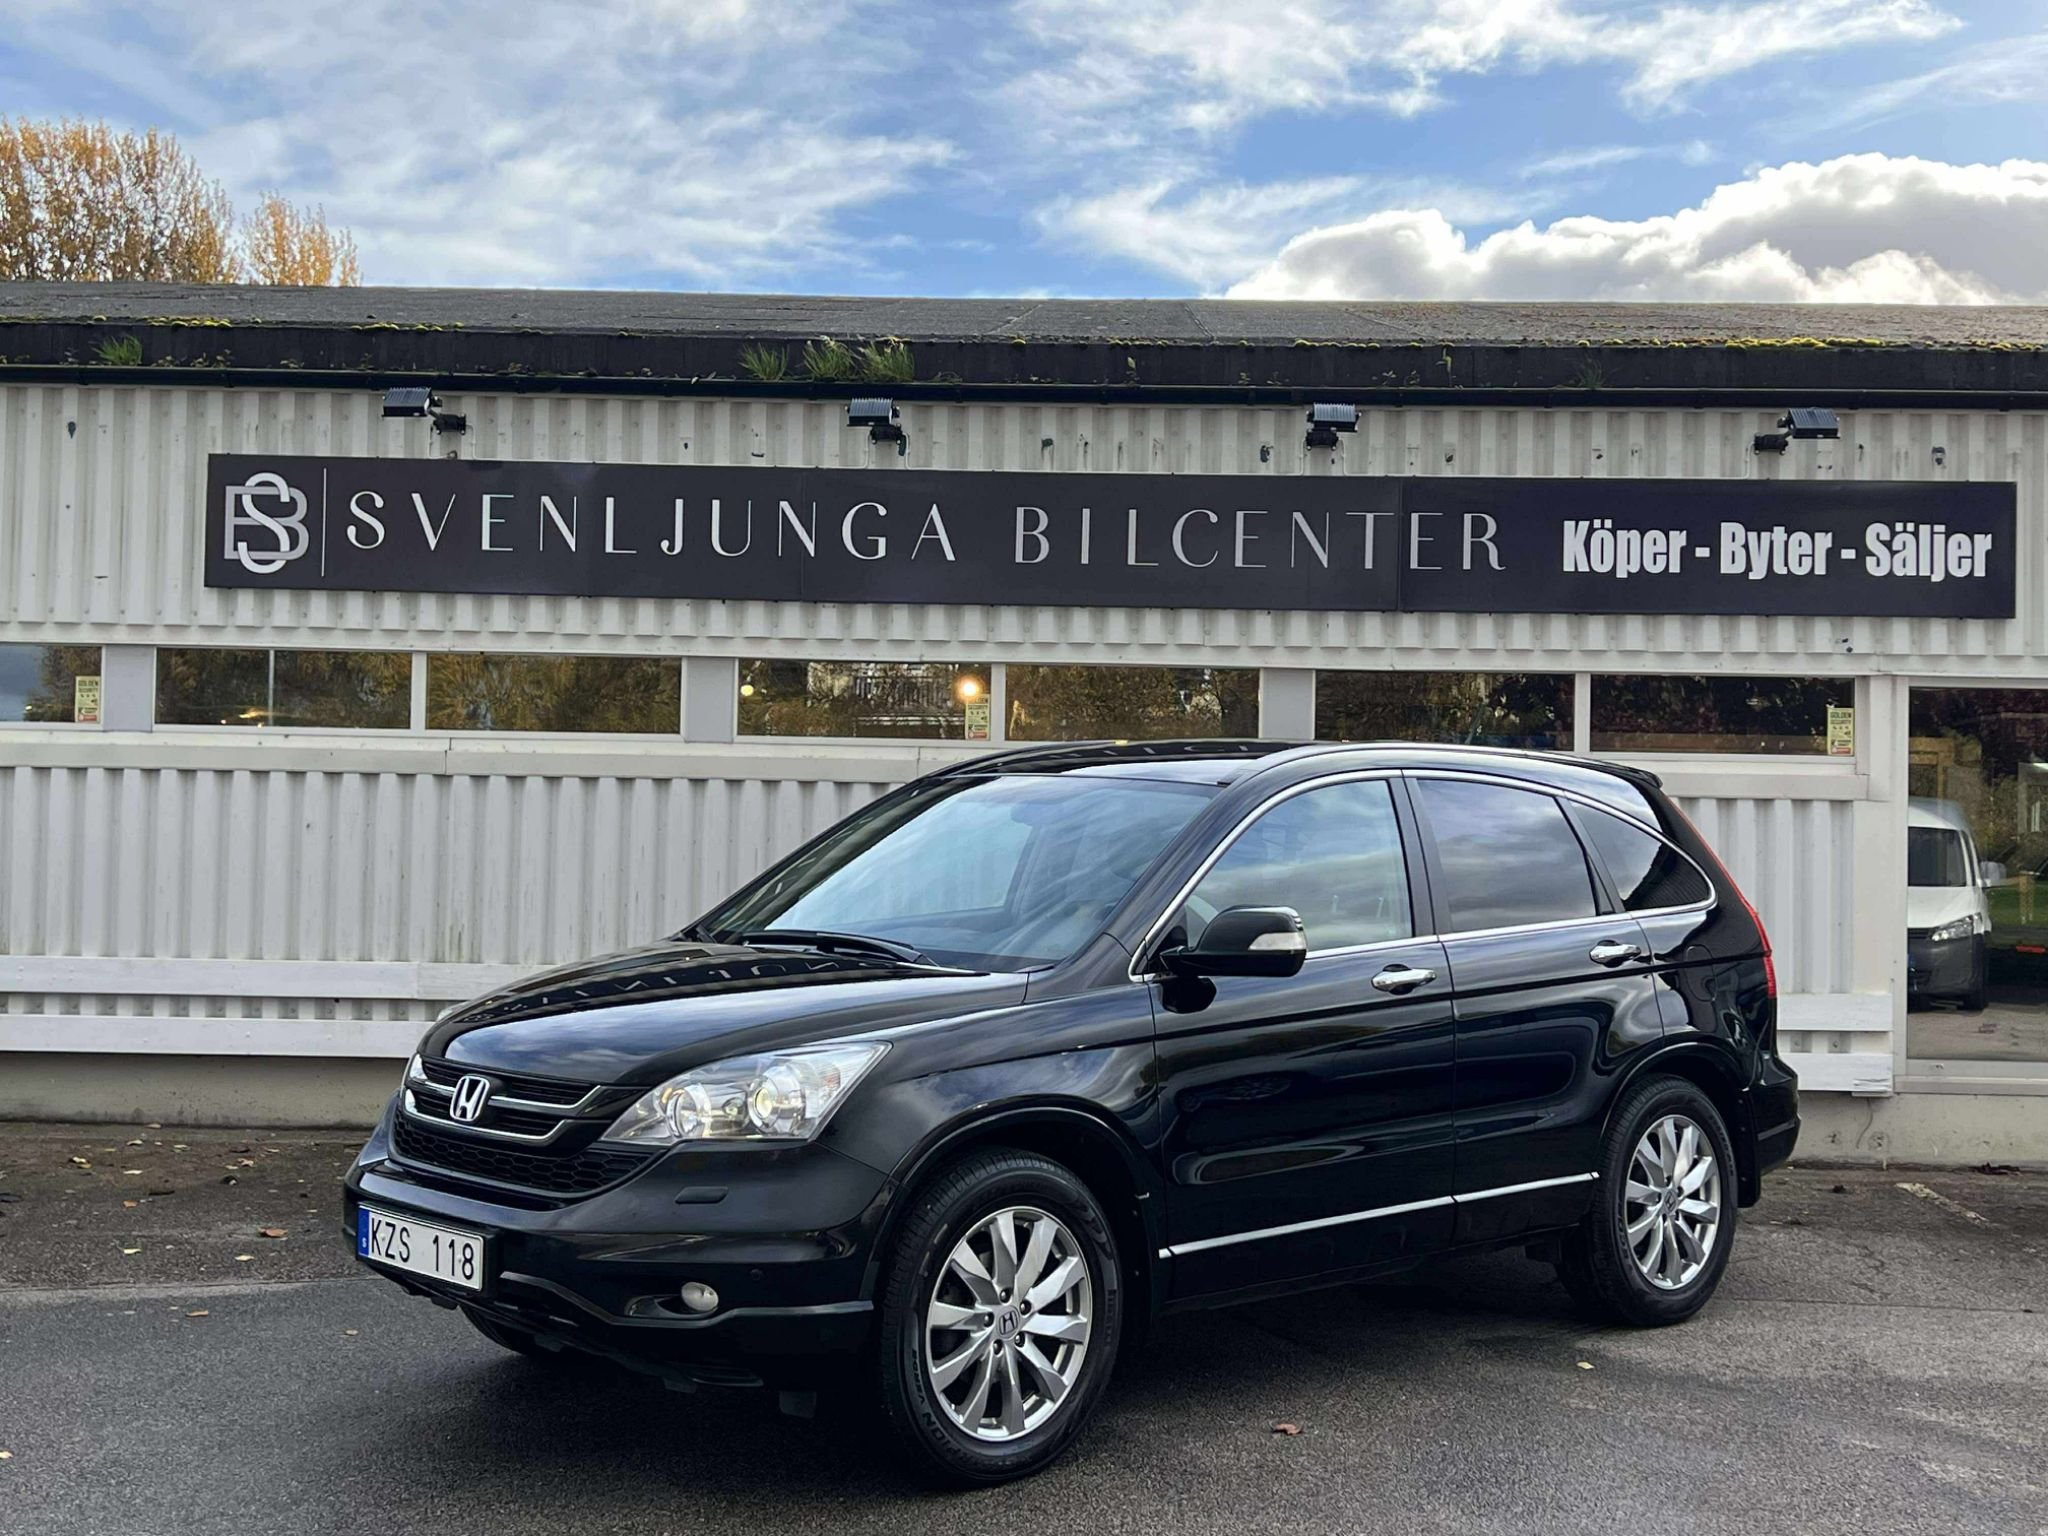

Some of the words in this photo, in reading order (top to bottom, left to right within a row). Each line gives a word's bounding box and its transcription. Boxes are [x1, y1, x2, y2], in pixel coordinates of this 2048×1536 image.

[346, 490, 956, 561] SVENLJUNGA
[1015, 506, 1506, 571] BILCENTER
[1562, 518, 1687, 579] Köper
[1720, 522, 1833, 580] Byter
[1865, 522, 1993, 583] Säljer
[371, 1217, 411, 1264] KZS
[432, 1234, 475, 1281] 118
